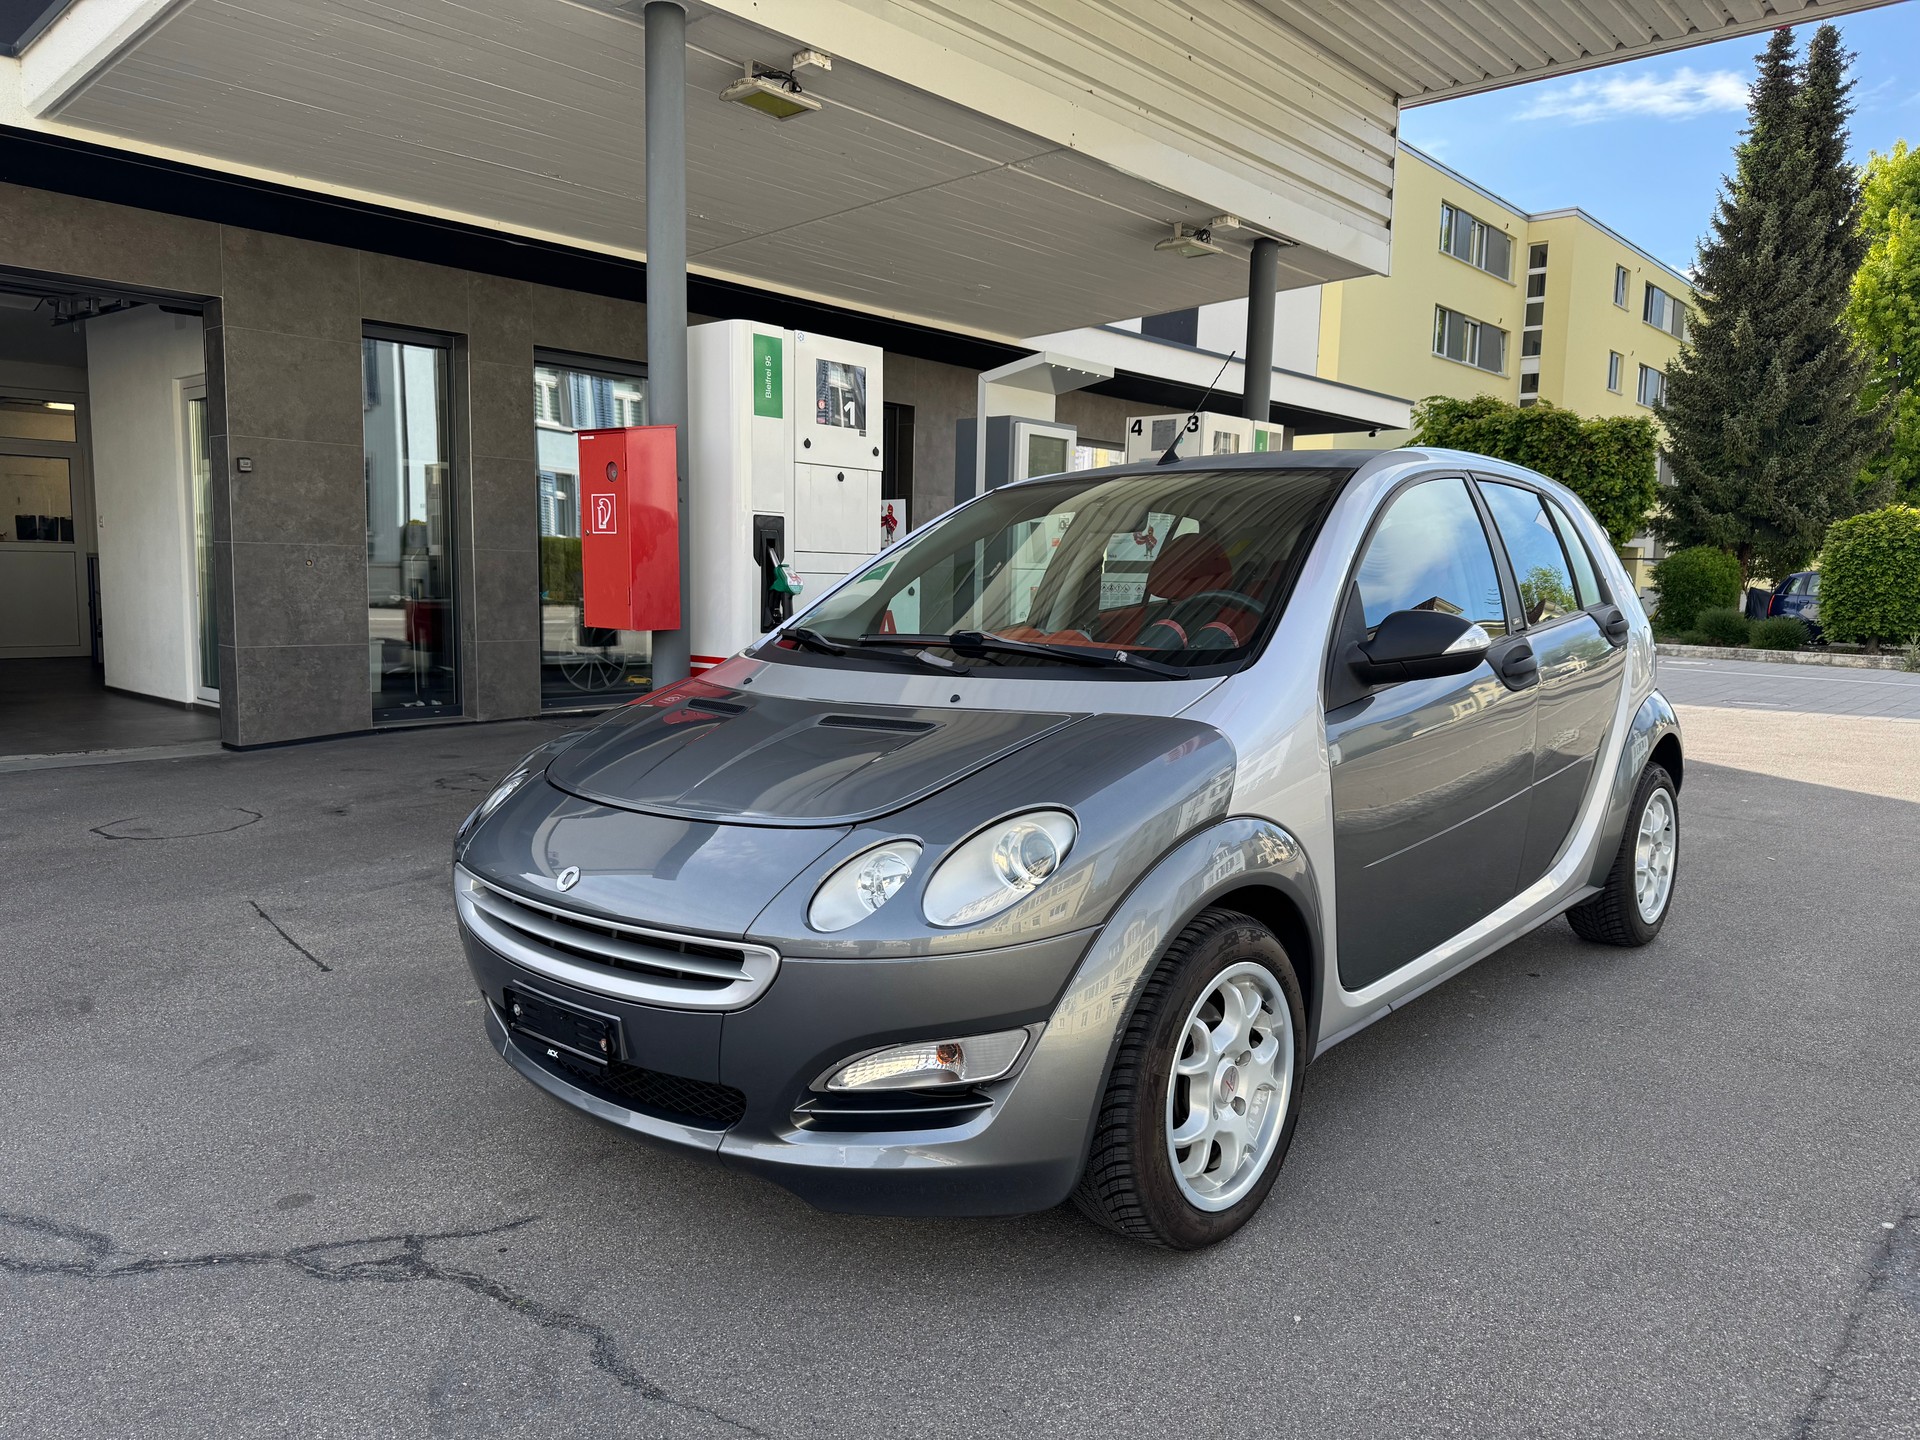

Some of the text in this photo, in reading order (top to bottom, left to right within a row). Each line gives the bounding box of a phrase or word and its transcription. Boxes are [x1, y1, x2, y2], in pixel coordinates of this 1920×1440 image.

[764, 355, 772, 367] 95
[843, 401, 856, 426] 1
[1130, 419, 1143, 437] 4
[1186, 415, 1199, 433] 3
